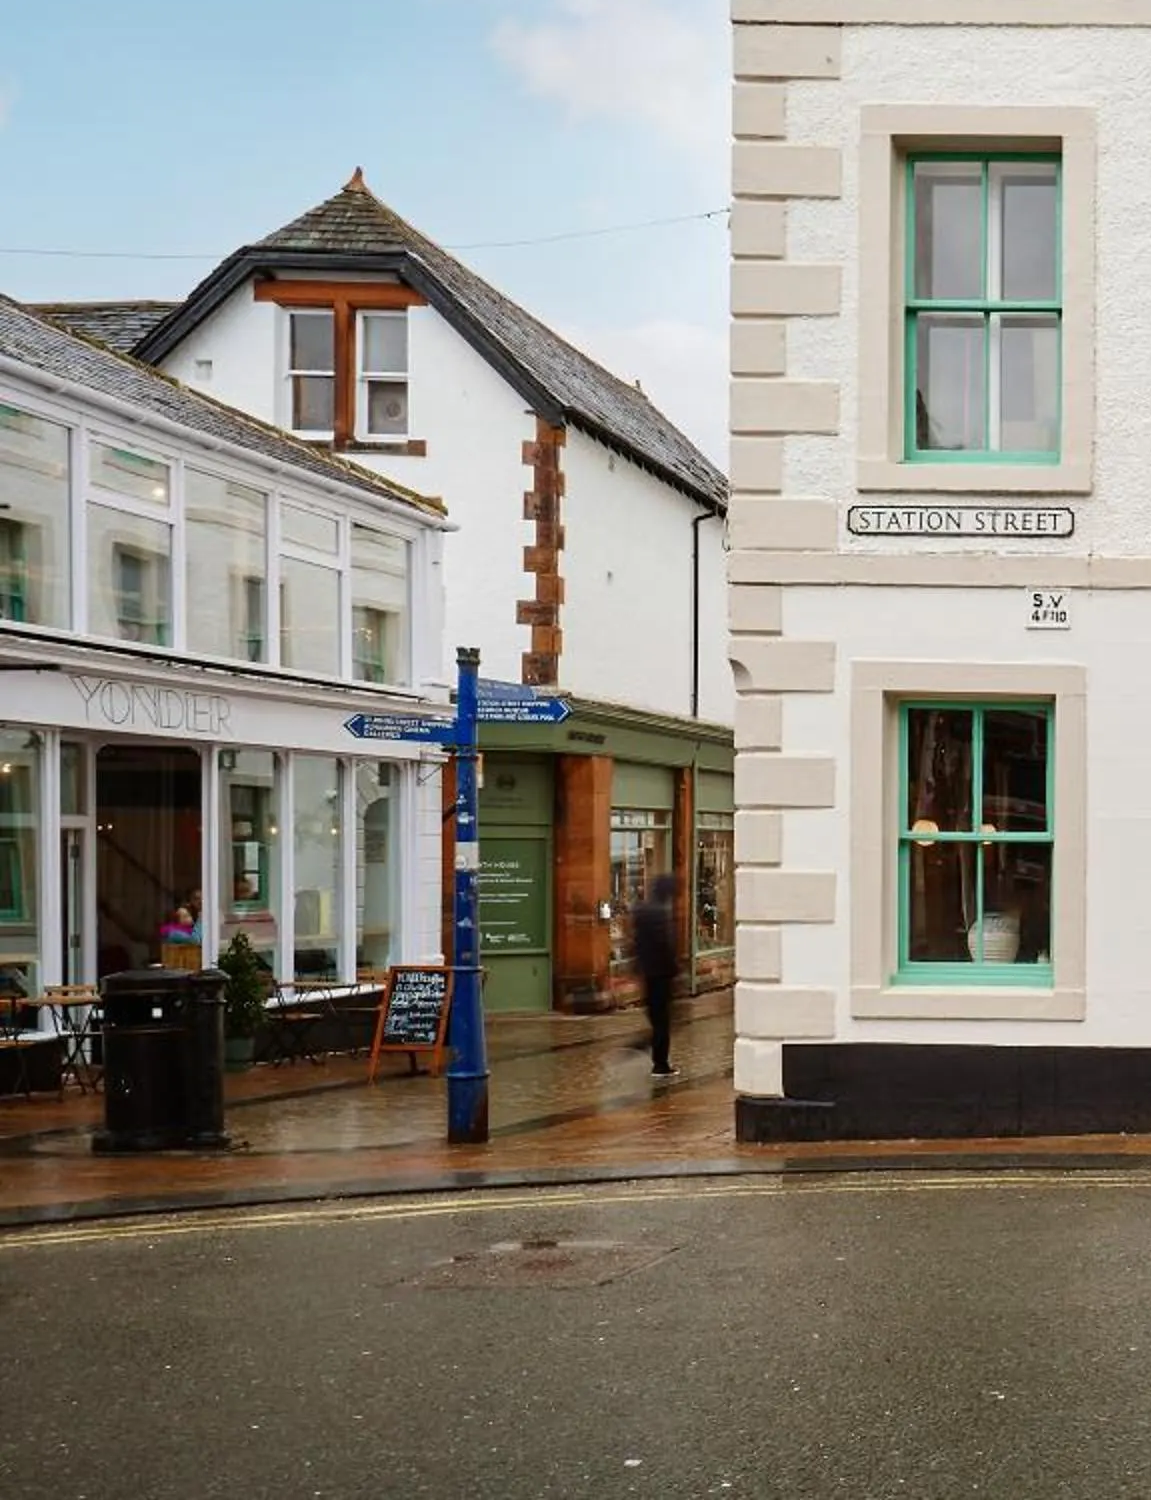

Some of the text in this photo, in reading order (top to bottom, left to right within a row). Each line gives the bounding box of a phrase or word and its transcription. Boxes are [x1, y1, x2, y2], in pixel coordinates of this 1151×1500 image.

[859, 511, 1063, 532] STATION STREET
[68, 675, 234, 738] YONDER
